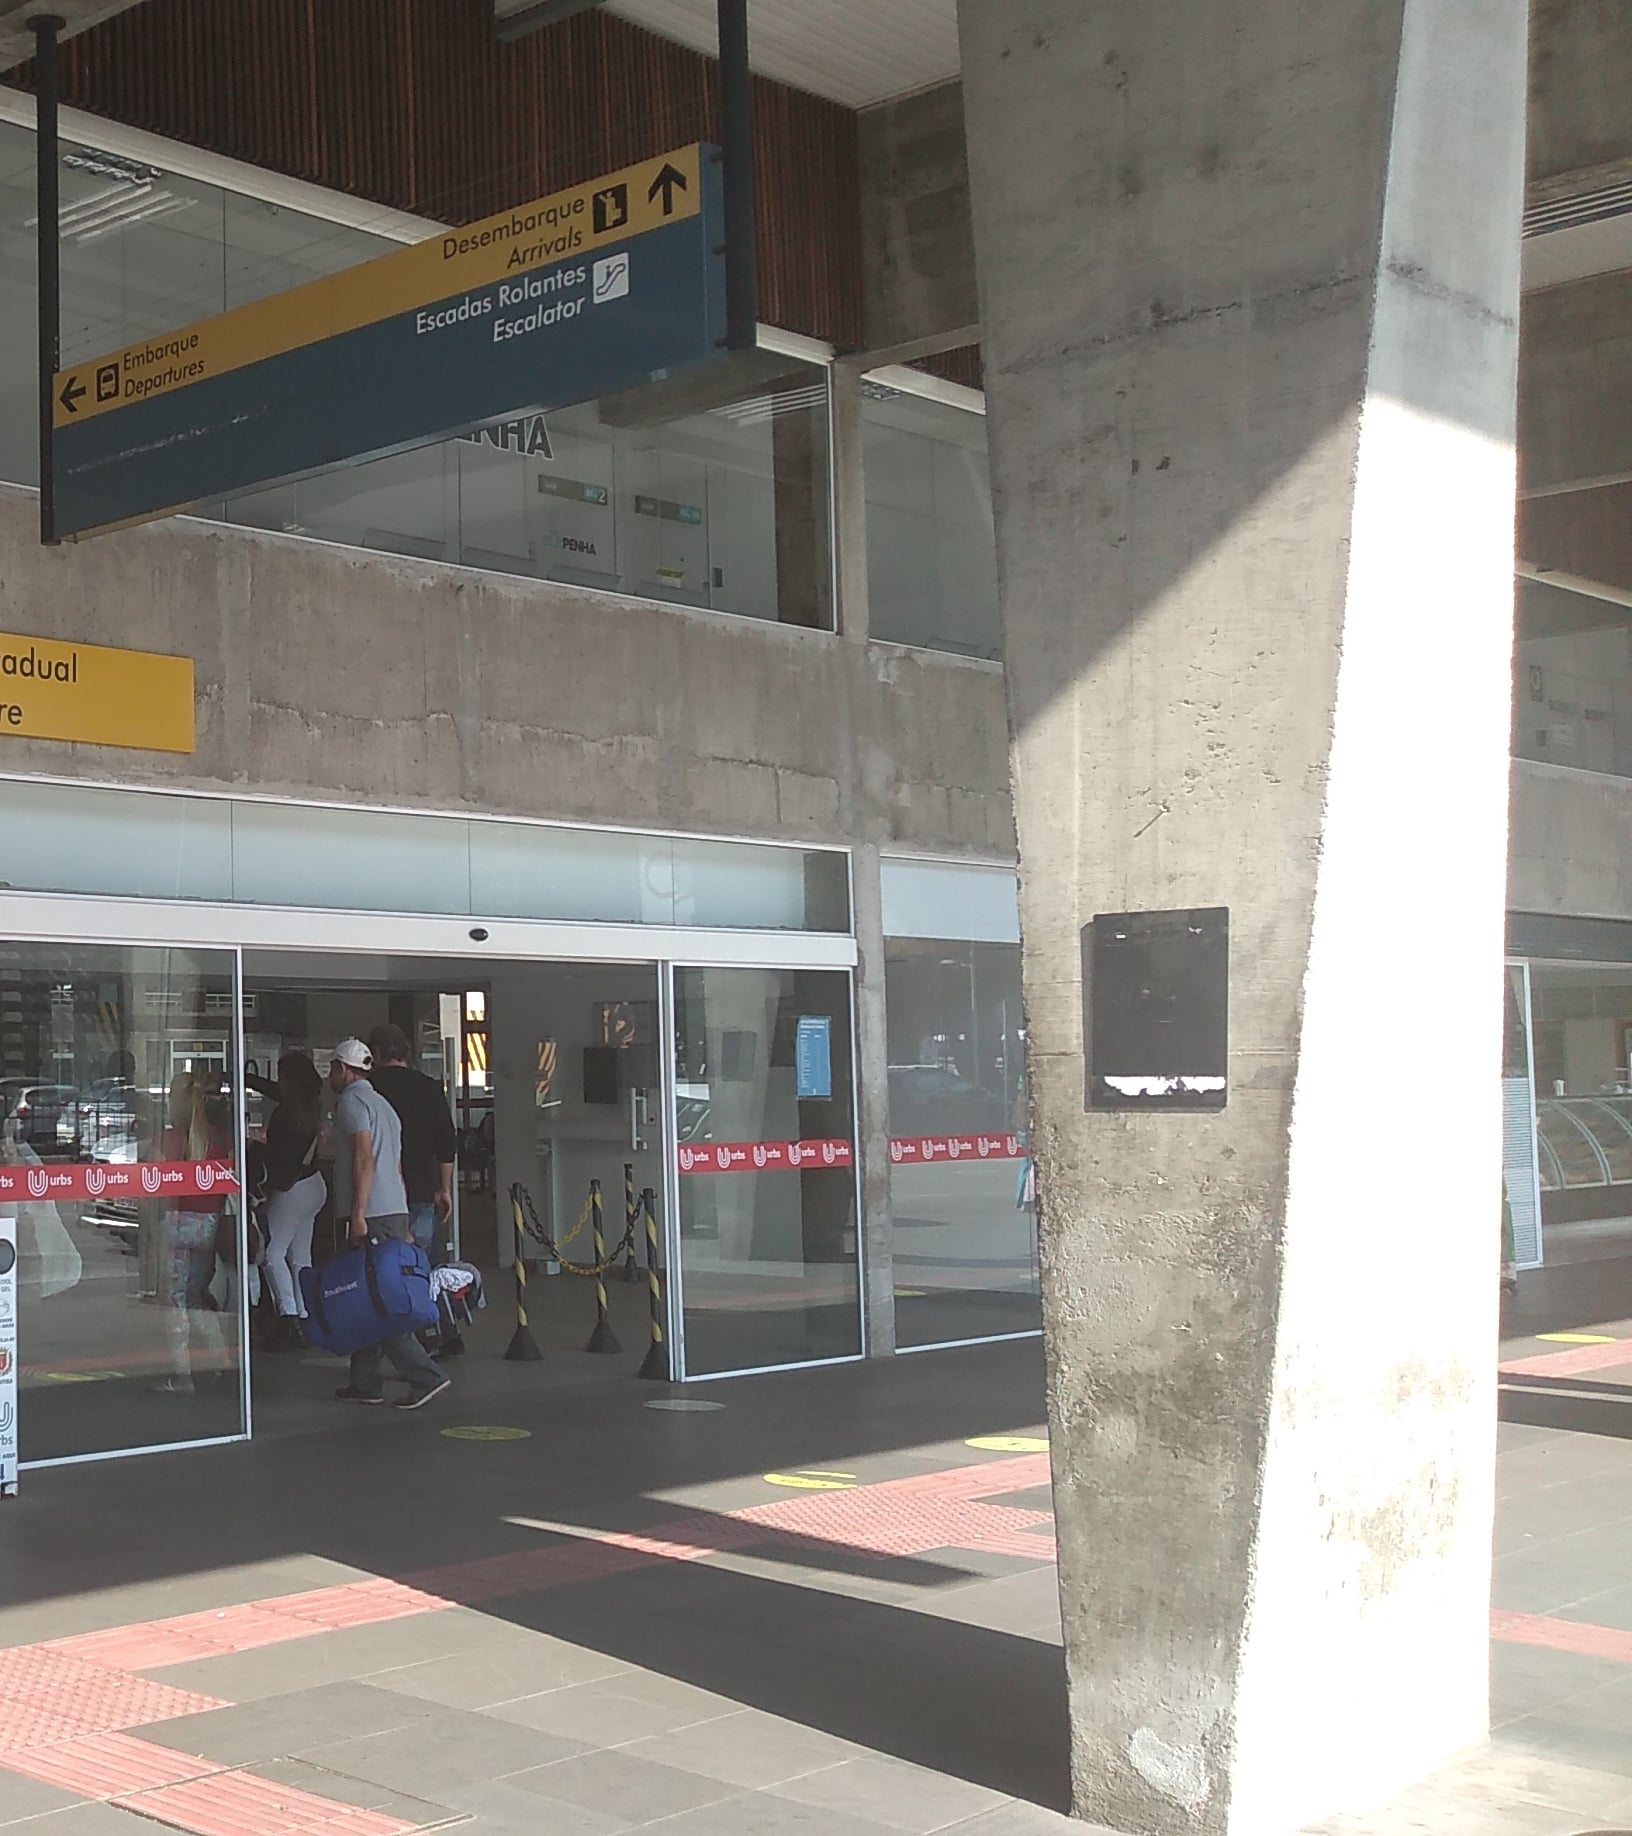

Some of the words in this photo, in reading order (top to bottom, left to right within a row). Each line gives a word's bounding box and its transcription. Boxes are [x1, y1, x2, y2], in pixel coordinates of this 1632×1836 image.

[443, 198, 585, 260] Desembarque
[507, 227, 582, 269] Arrivals
[416, 296, 492, 334] Escadas
[498, 266, 586, 308] Rolantes
[493, 296, 585, 342] Escalator
[124, 334, 199, 371] Embarque
[125, 360, 204, 398] Departures
[456, 414, 554, 460] NHA
[562, 537, 596, 555] PENHA
[49, 1174, 73, 1186] urbs
[107, 1172, 129, 1184] urbs
[162, 1169, 183, 1182] urbs
